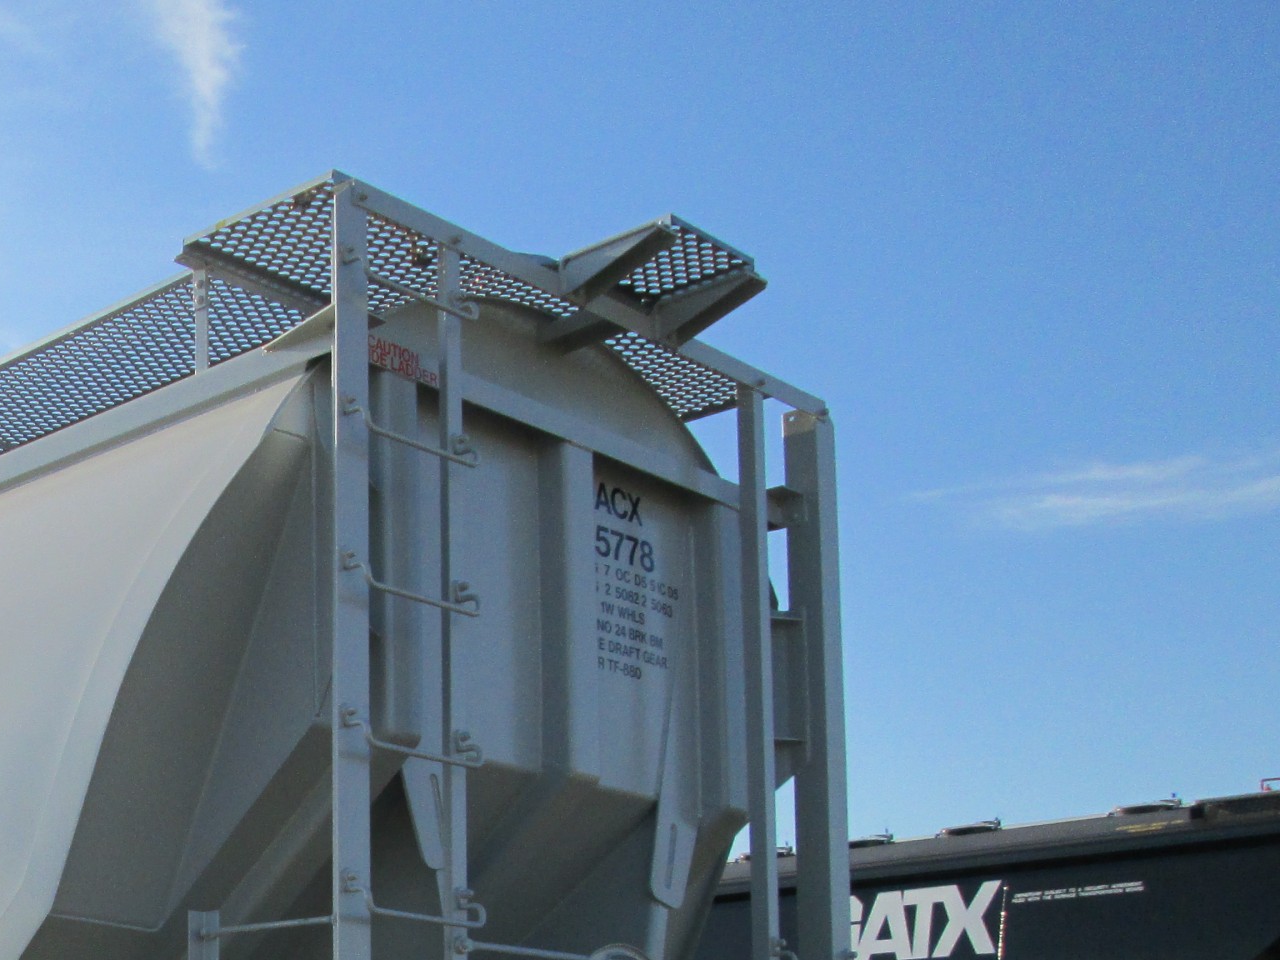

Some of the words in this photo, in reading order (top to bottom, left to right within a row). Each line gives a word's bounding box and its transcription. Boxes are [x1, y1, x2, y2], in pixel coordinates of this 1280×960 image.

[594, 482, 643, 527] ACX
[595, 525, 655, 573] 5778
[608, 640, 641, 660] DRAFT
[643, 650, 668, 670] GEAR
